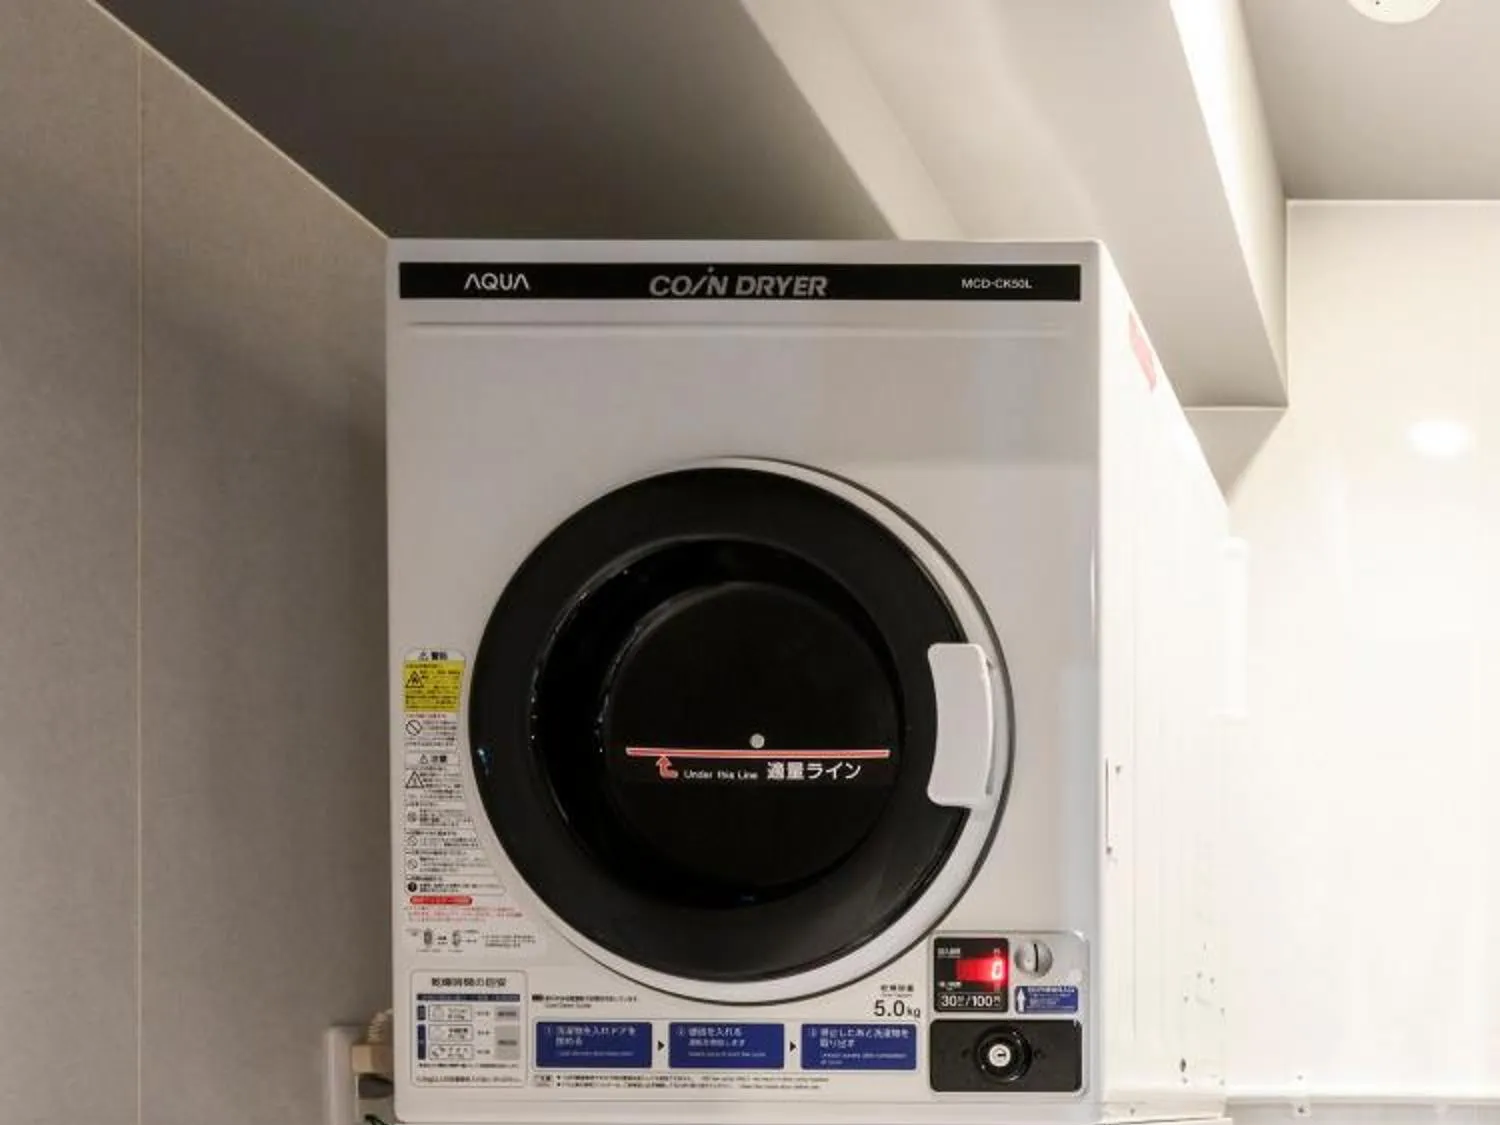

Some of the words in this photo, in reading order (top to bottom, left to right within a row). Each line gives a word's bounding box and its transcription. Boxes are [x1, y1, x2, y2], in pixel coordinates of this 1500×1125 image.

[464, 272, 530, 292] AQUA
[735, 275, 829, 297] DRYER
[683, 769, 713, 780] Under
[767, 761, 862, 780] 適量ライン
[873, 999, 921, 1019] 5.0kg
